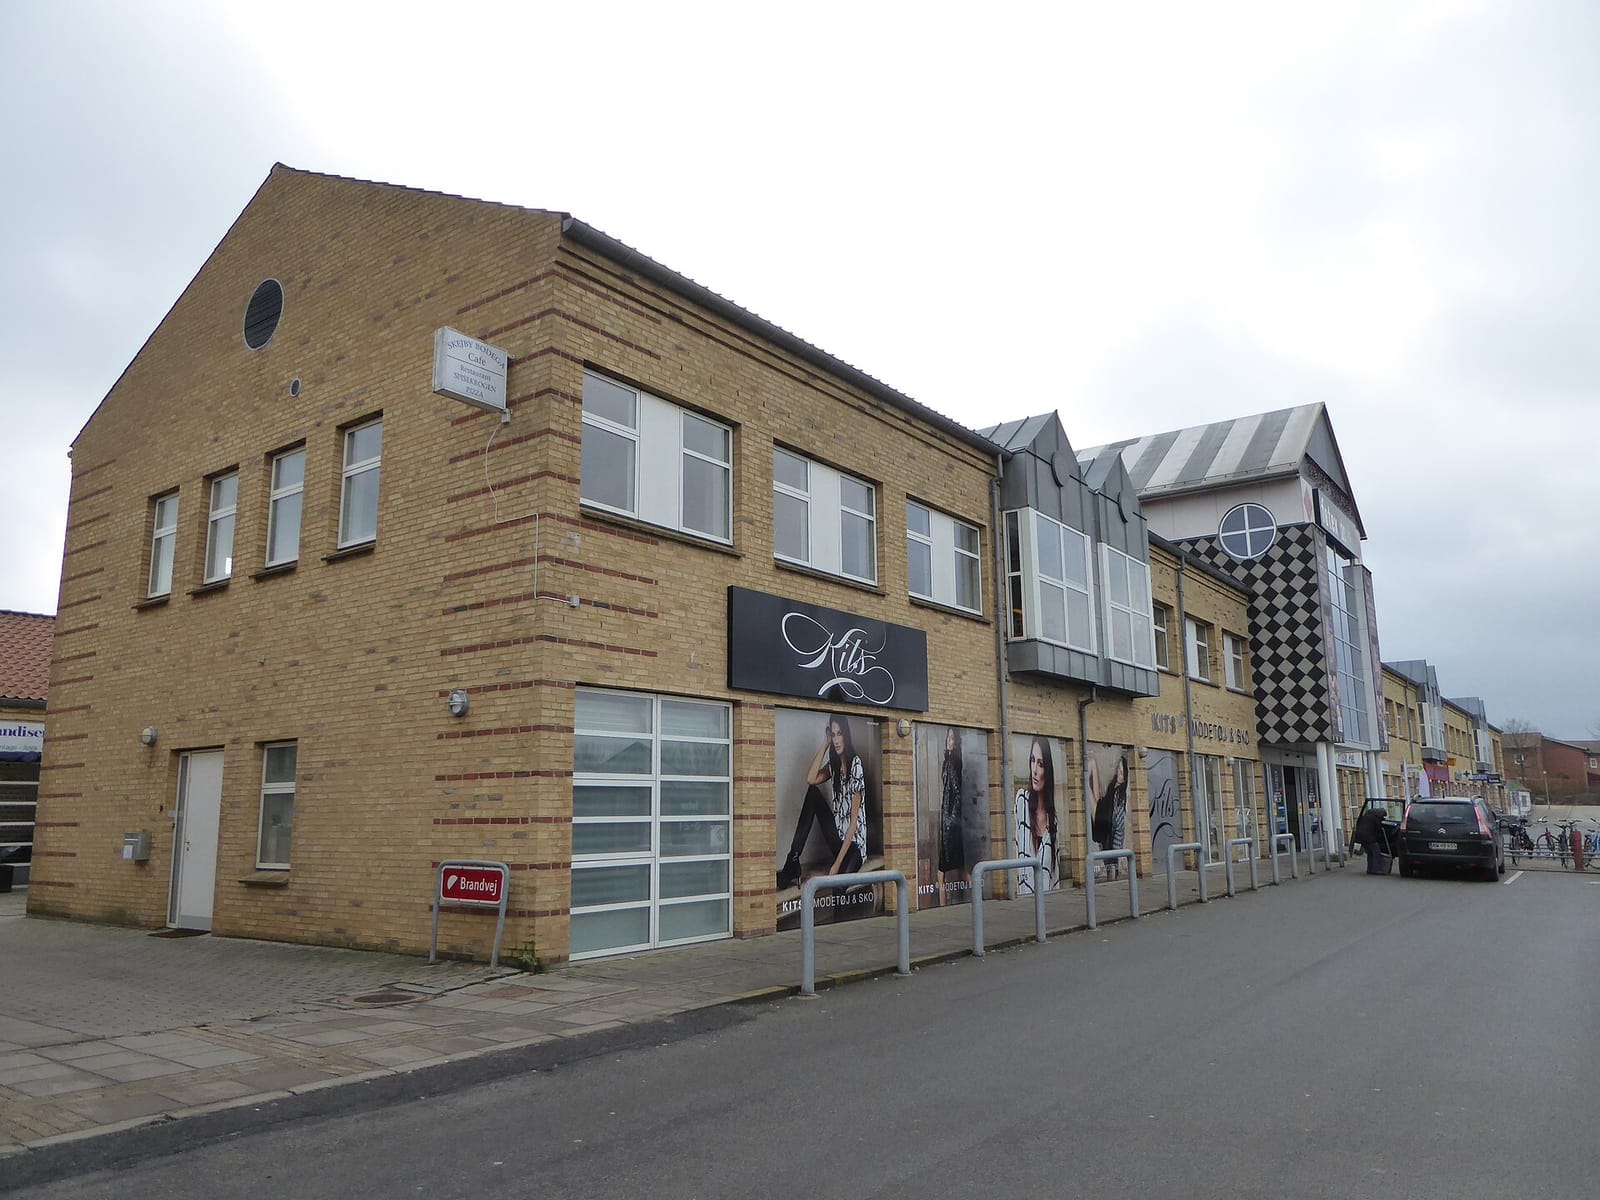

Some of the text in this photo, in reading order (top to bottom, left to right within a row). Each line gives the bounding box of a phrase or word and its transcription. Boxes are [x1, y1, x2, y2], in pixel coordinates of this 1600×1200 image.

[475, 343, 504, 368] BODEGA
[1151, 712, 1177, 735] KITS
[1237, 728, 1250, 746] SKO
[460, 876, 498, 896] Brandvej
[918, 884, 935, 895] KITS
[852, 896, 857, 904] &
[858, 892, 874, 903] SKO
